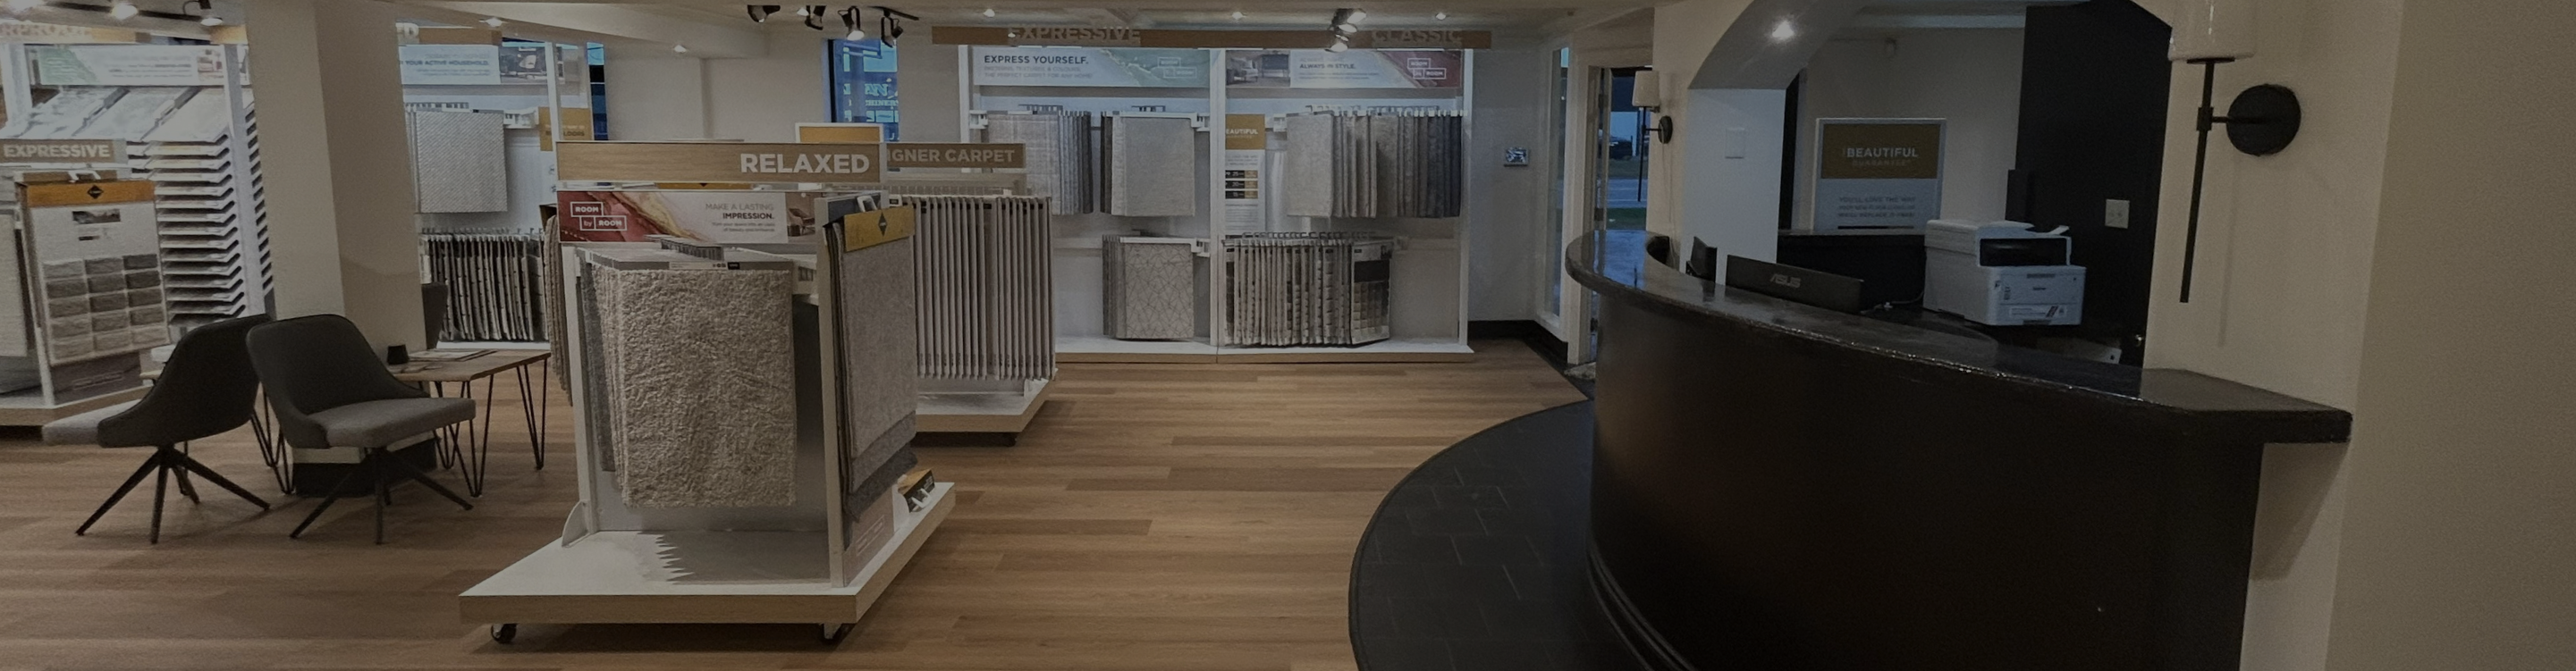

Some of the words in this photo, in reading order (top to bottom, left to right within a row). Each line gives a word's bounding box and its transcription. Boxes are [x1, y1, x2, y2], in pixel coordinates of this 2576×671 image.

[1008, 27, 1140, 41] EXPRESSIVE
[1372, 29, 1461, 43] CLASSIC
[984, 55, 1030, 63] EXPRESS
[1033, 55, 1089, 64] YOURSELF.
[4, 144, 111, 159] EXPRESSIVE
[945, 148, 1016, 163] CARPET
[1846, 147, 1919, 158] BEAUTIFUL
[740, 153, 870, 174] RELAXED
[739, 203, 774, 211] LASTING
[722, 212, 775, 220] IMPRESSION.
[1769, 273, 1802, 289] ASUS
